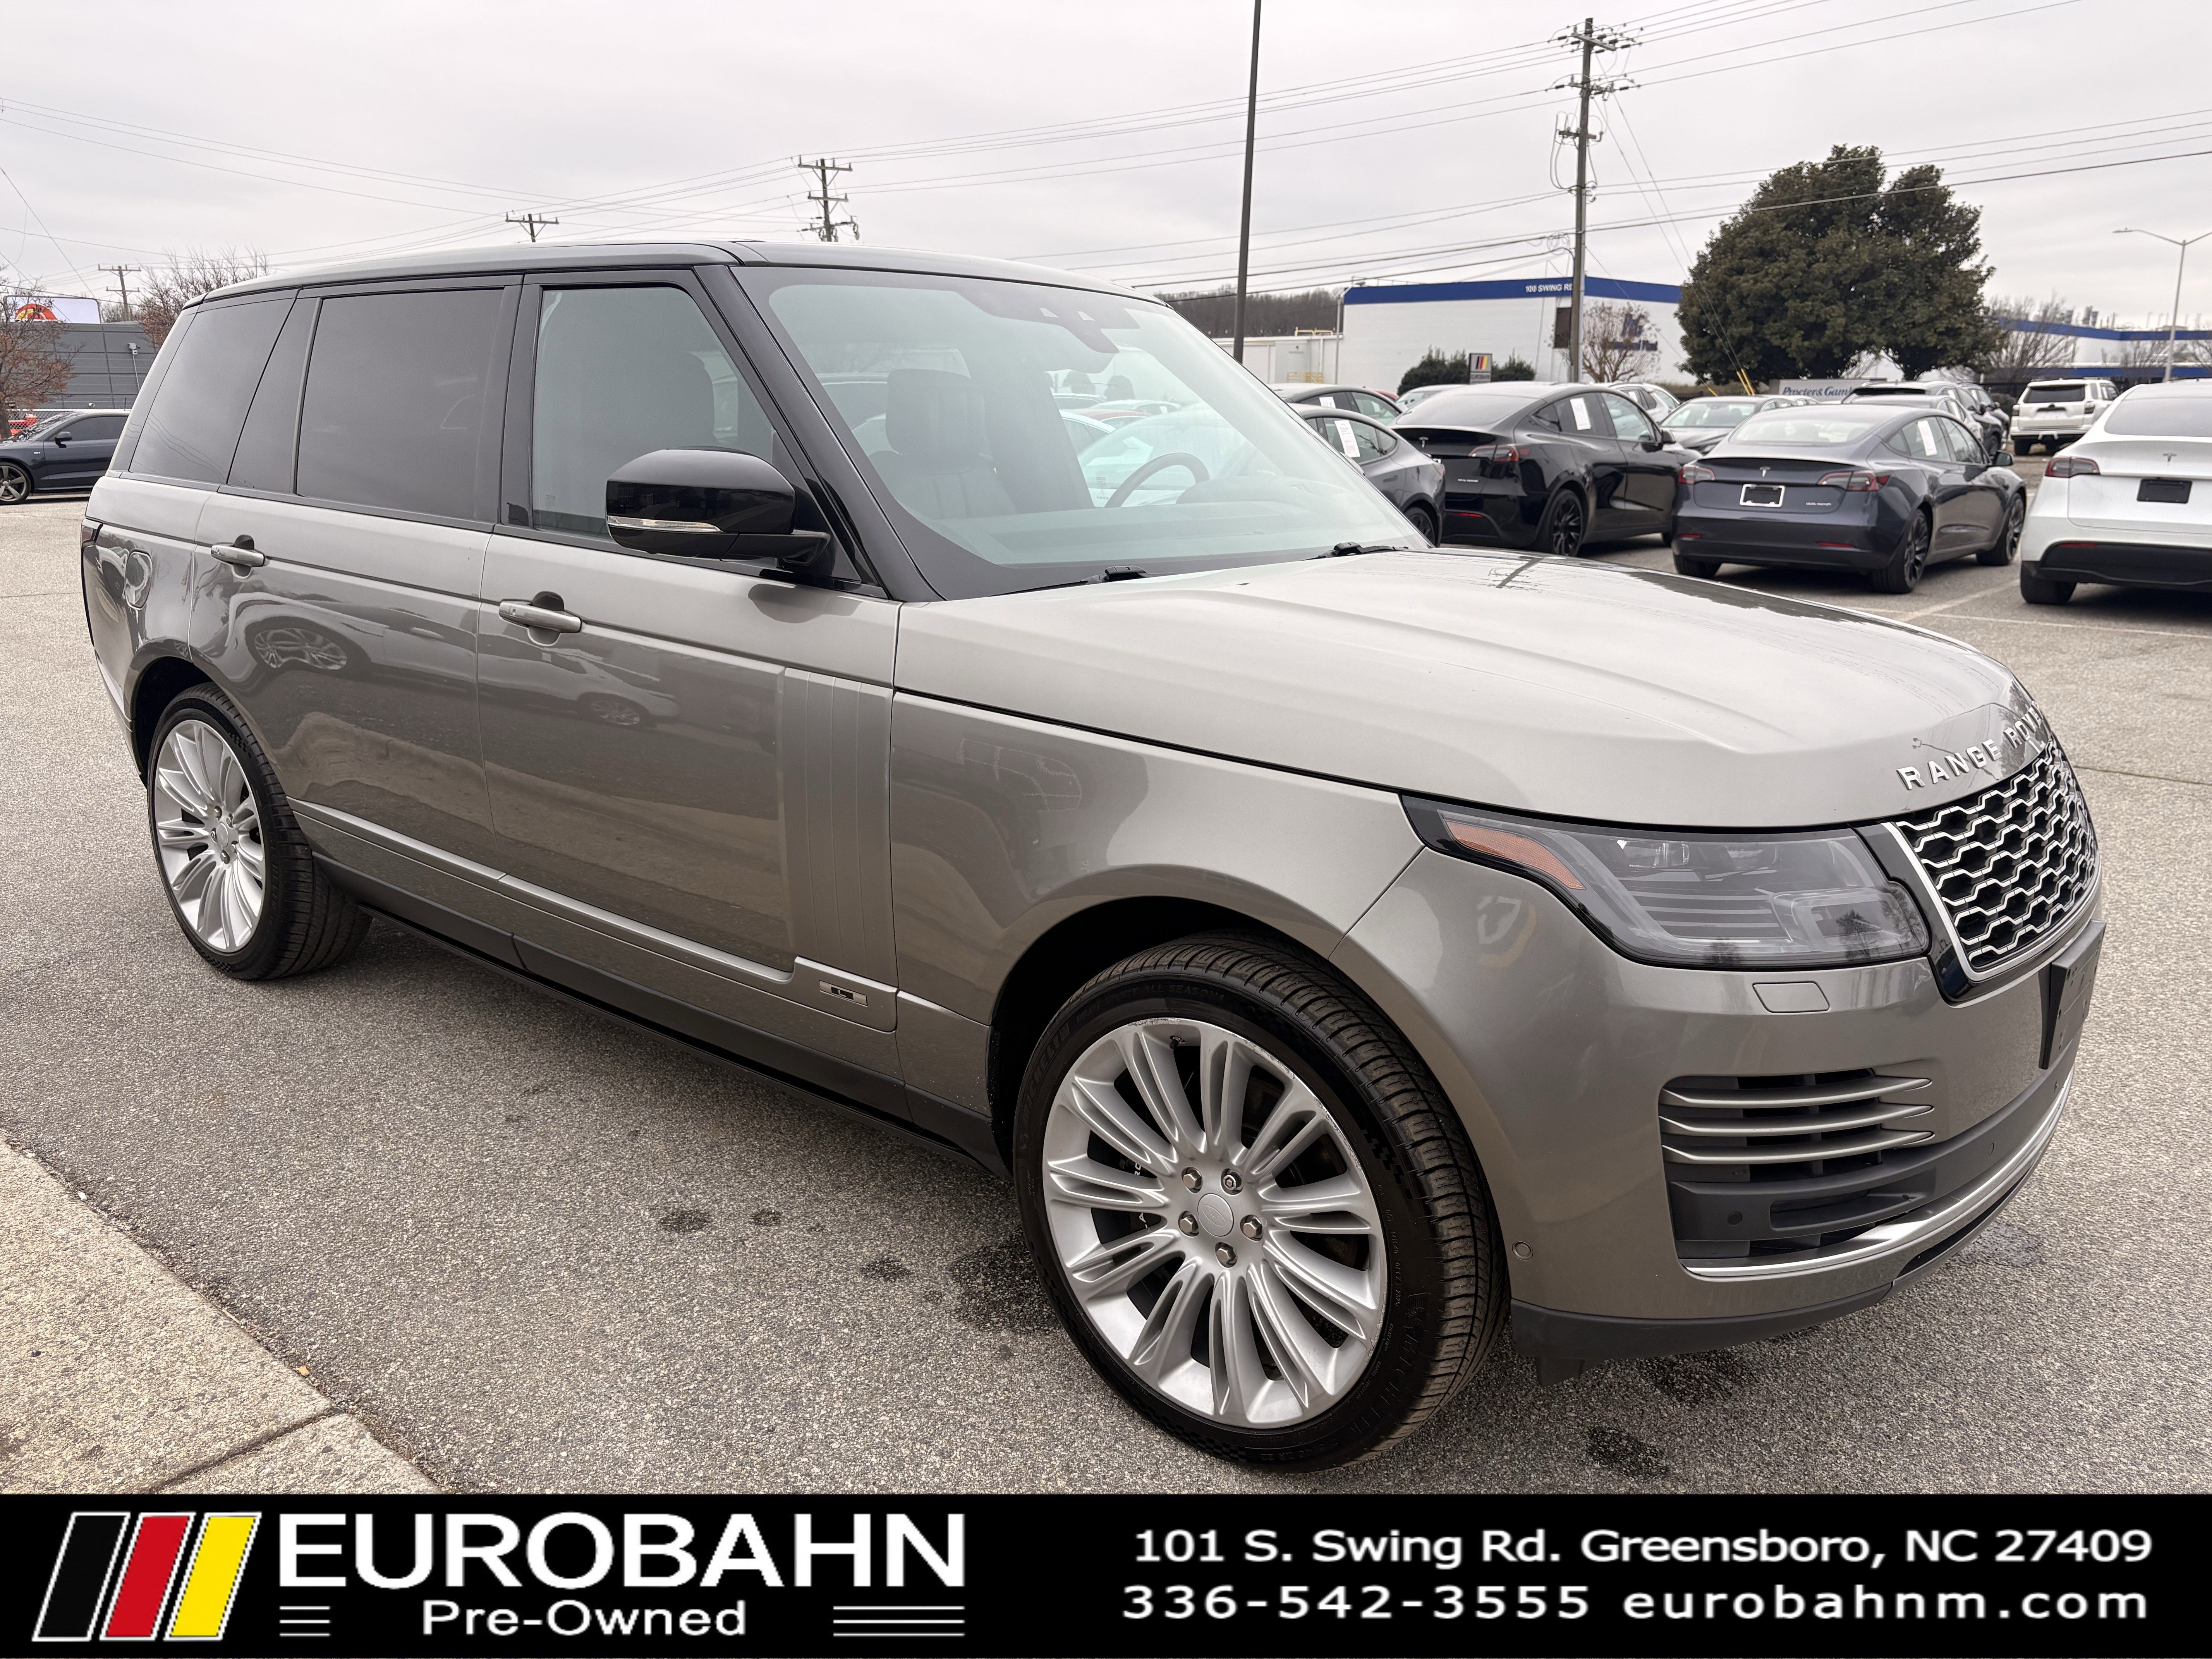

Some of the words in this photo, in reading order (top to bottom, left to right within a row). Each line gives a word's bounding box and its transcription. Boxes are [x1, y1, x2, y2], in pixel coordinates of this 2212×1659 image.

[1538, 283, 1563, 292] SWING
[1896, 739, 2002, 790] RANGE
[1022, 1023, 1070, 1127] MICHELIN
